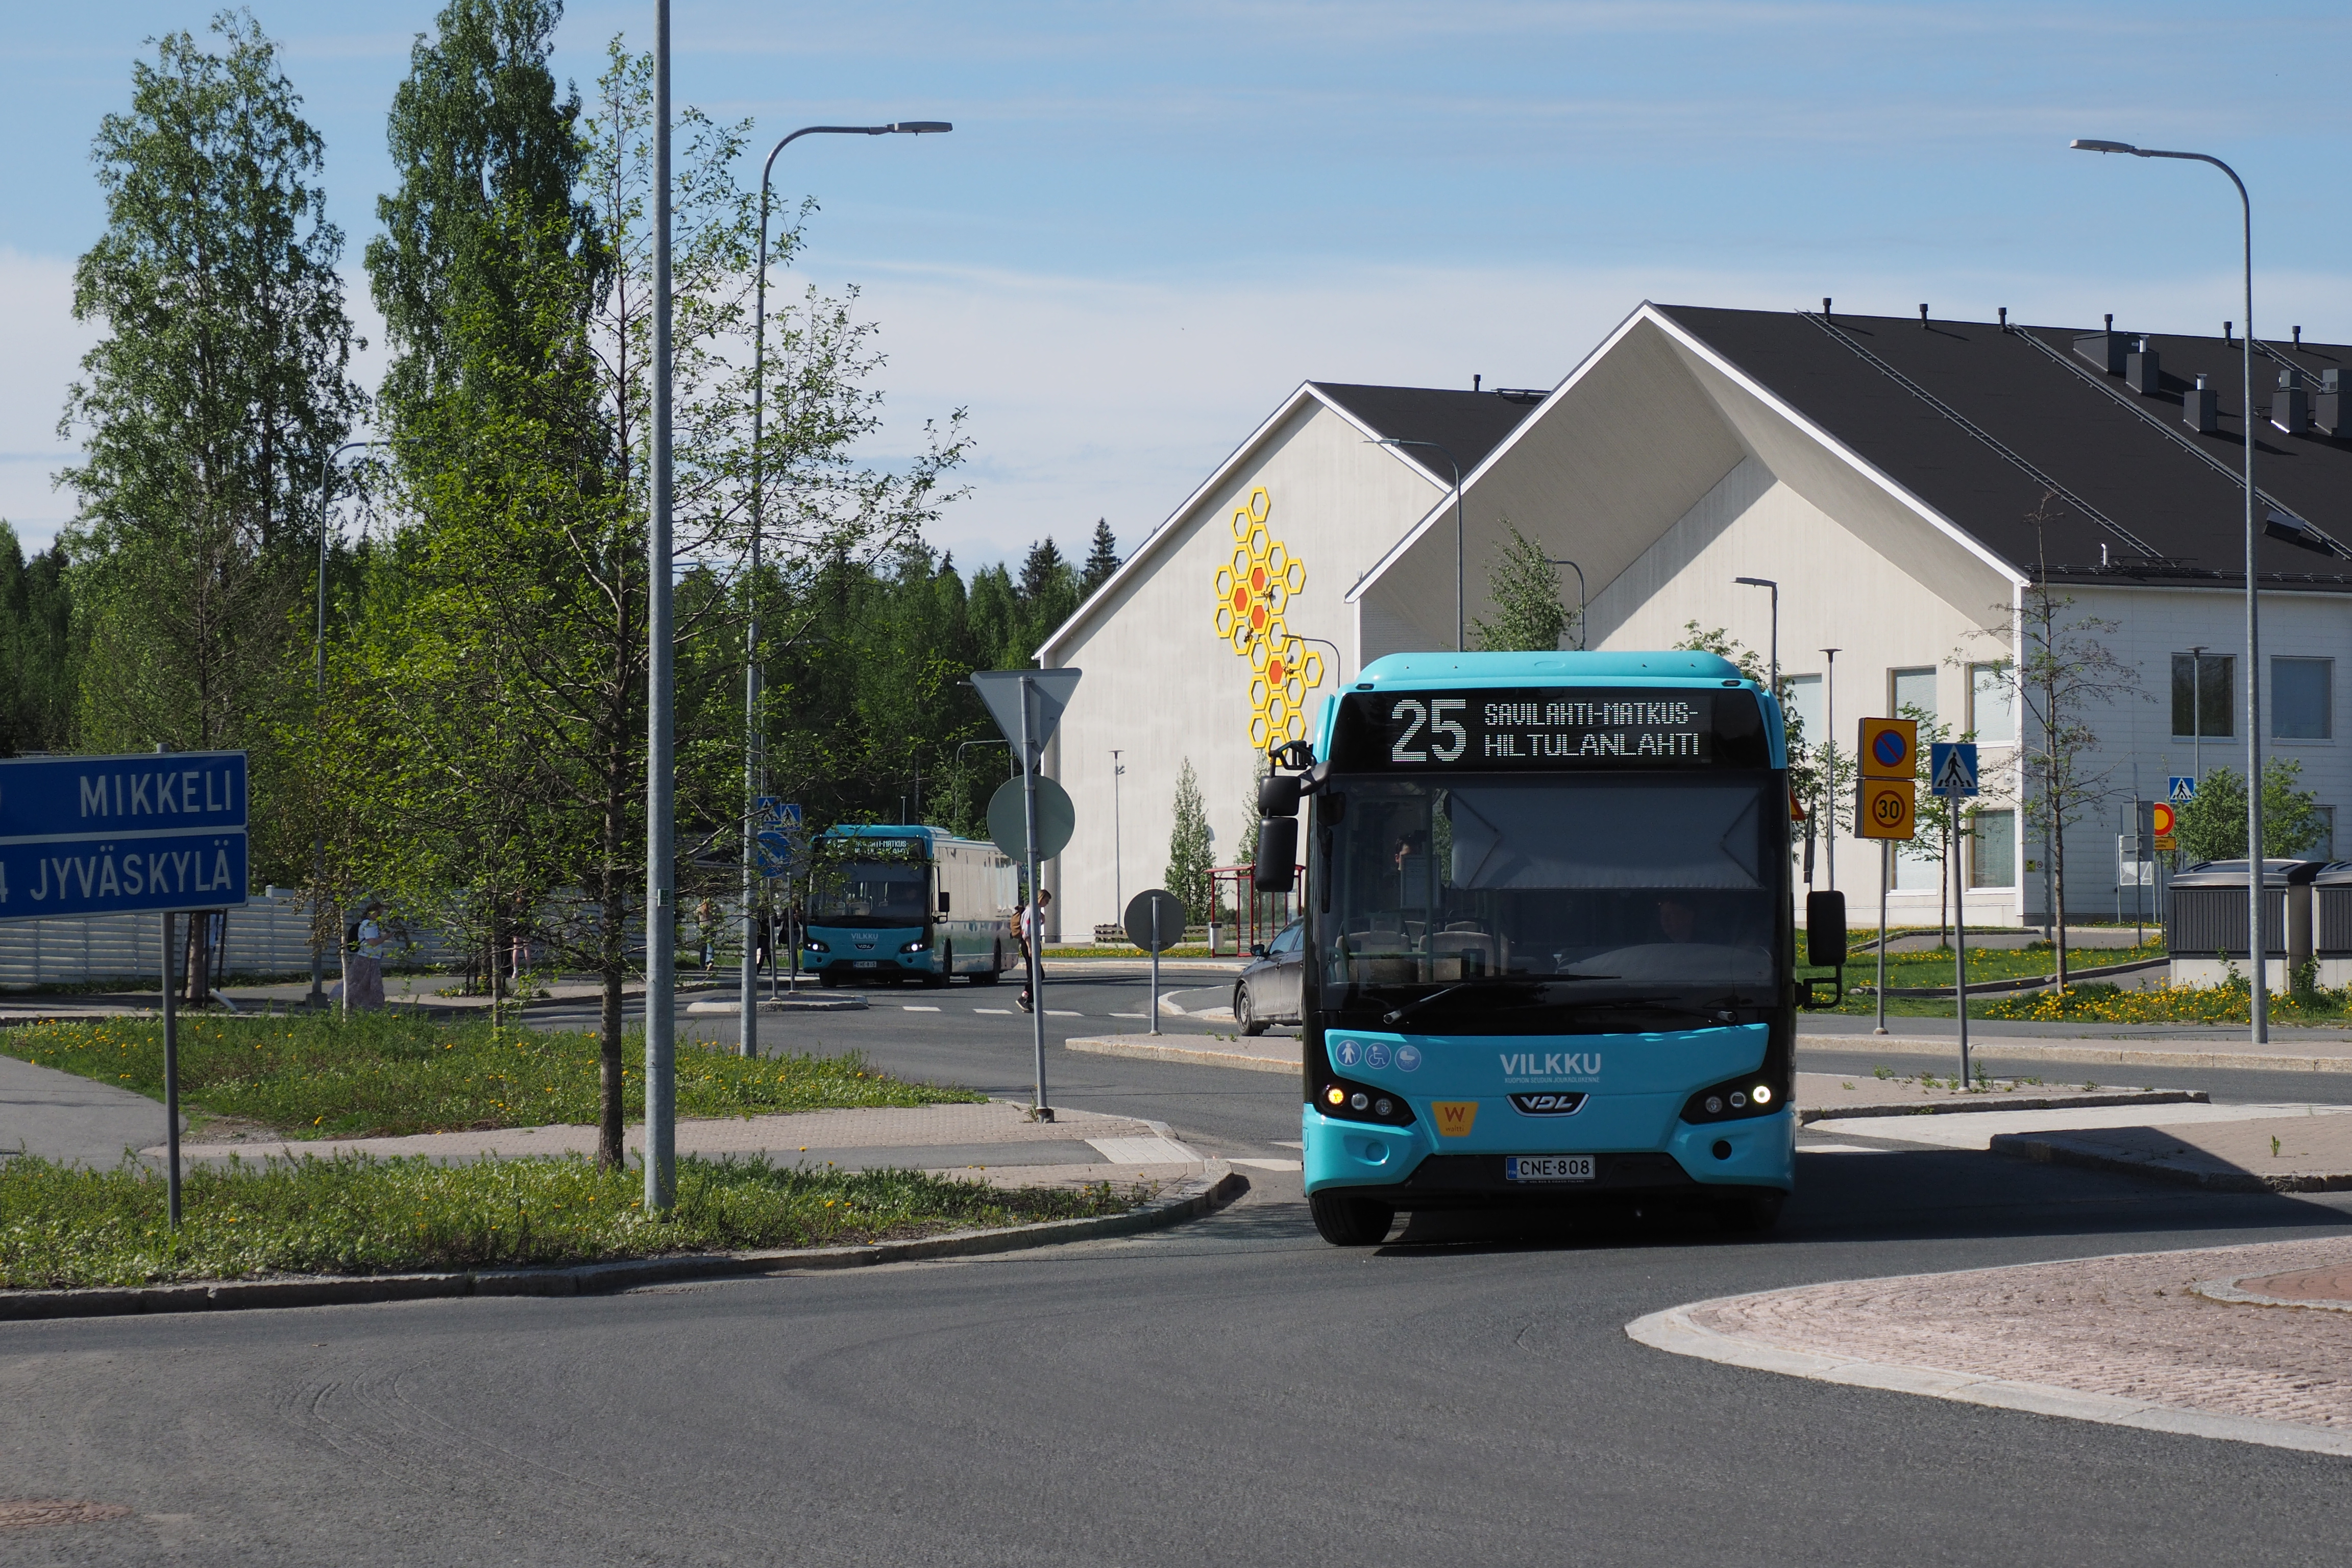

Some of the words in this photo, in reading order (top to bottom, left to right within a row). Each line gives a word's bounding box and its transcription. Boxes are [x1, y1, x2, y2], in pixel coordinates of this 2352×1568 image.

[1484, 702, 1699, 726] SAVILAHTI-MATKUS-
[1391, 699, 1466, 762] 25
[1484, 733, 1699, 757] HILTULANLAHTI
[80, 770, 231, 818] MIKKELI
[1878, 799, 1900, 819] 30
[30, 839, 232, 901] JYVÄSKYLÄ
[1500, 1053, 1601, 1074] VILKKU
[1520, 1096, 1573, 1110] VDL
[1444, 1107, 1465, 1122] W
[1520, 1160, 1589, 1175] CNE-808
